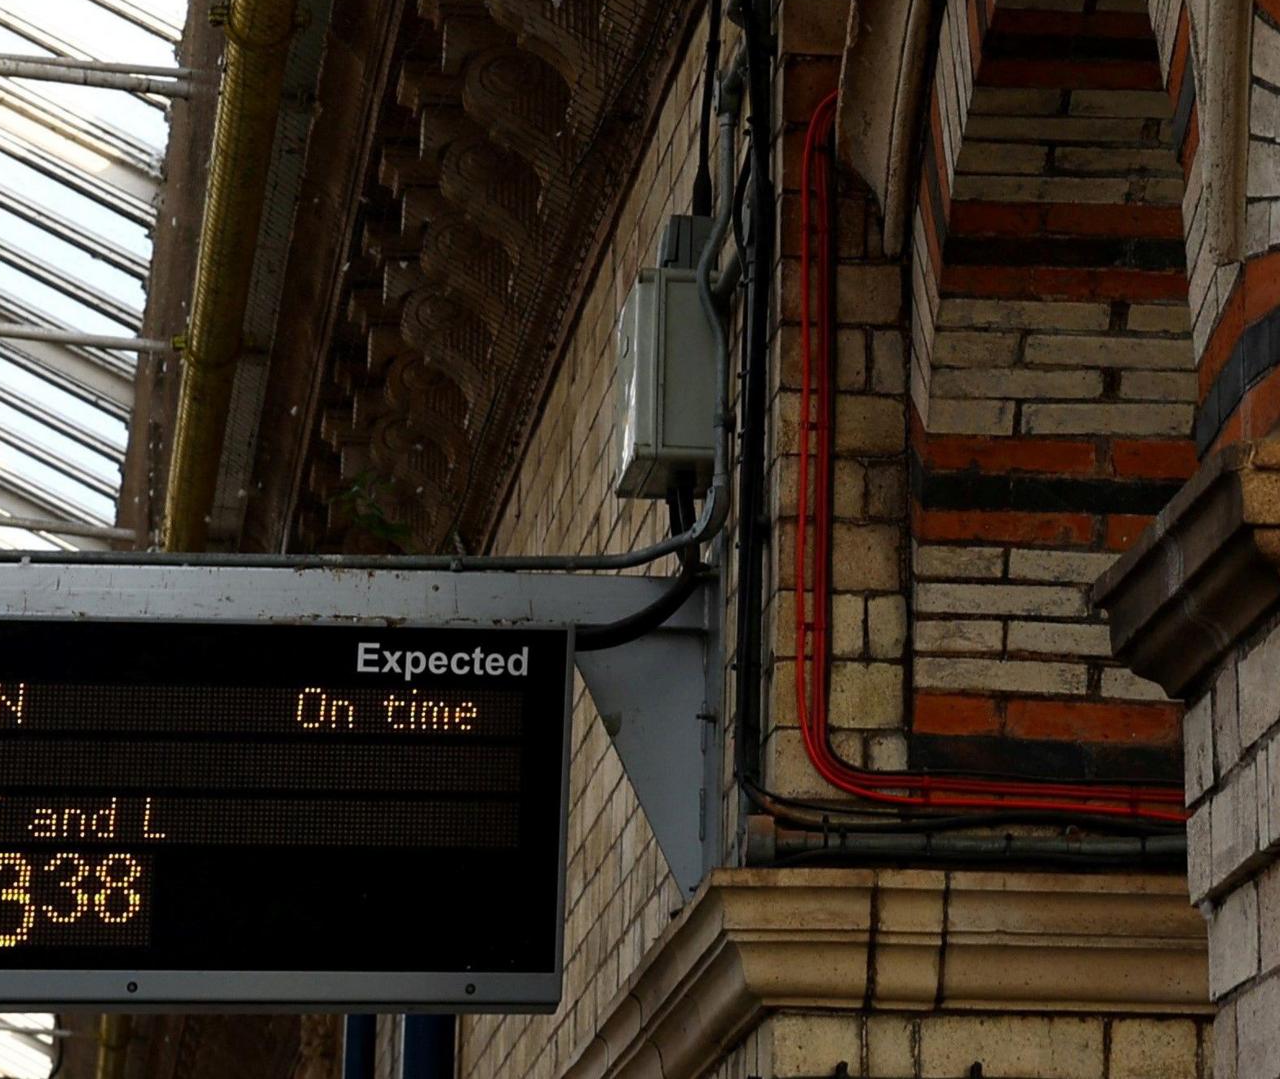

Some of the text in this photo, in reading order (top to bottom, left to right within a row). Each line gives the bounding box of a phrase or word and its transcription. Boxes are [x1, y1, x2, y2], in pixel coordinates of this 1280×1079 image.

[356, 641, 530, 682] Expected
[295, 686, 355, 730] On
[382, 688, 478, 731] time
[27, 796, 118, 839] and
[142, 796, 167, 839] L
